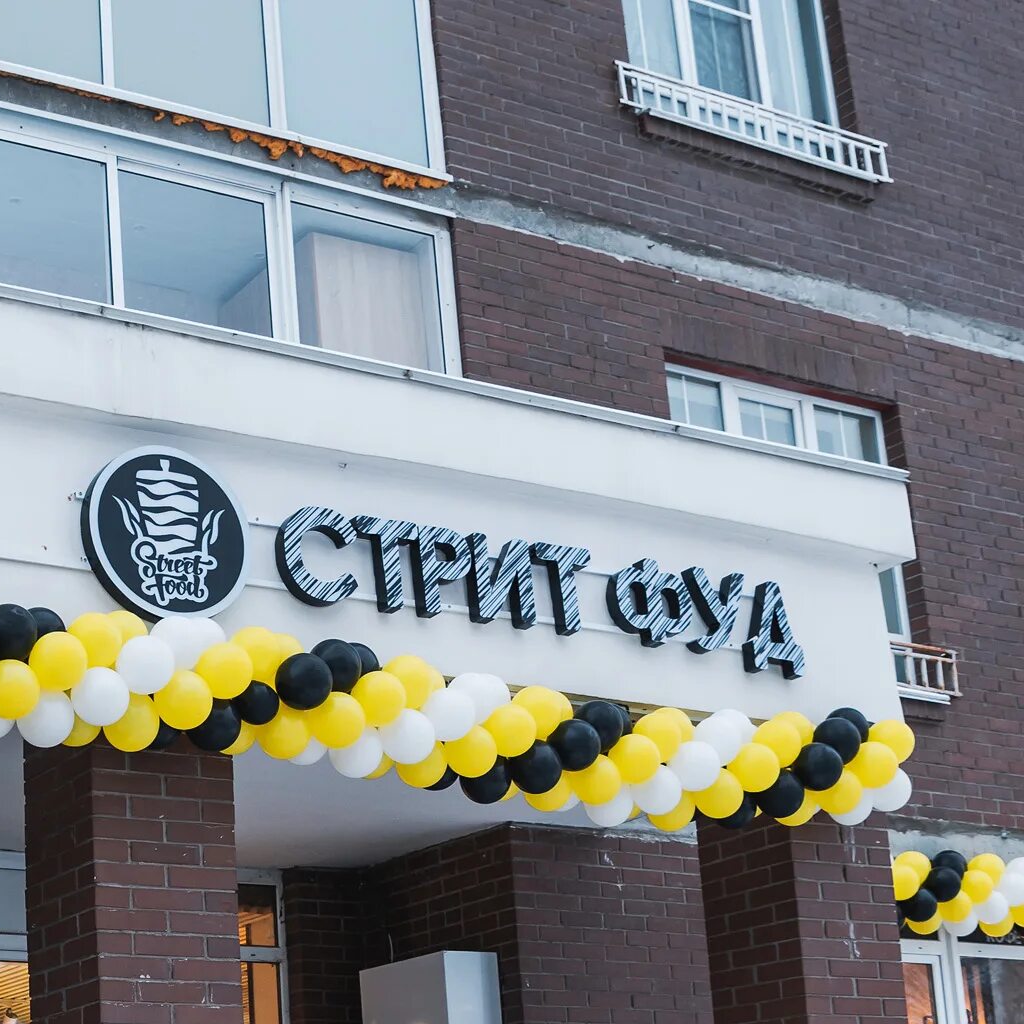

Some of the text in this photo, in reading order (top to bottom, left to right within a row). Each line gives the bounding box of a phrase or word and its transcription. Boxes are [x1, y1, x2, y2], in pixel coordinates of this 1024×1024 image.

[134, 540, 214, 578] Street
[275, 506, 805, 680] СТРИТ ФУД
